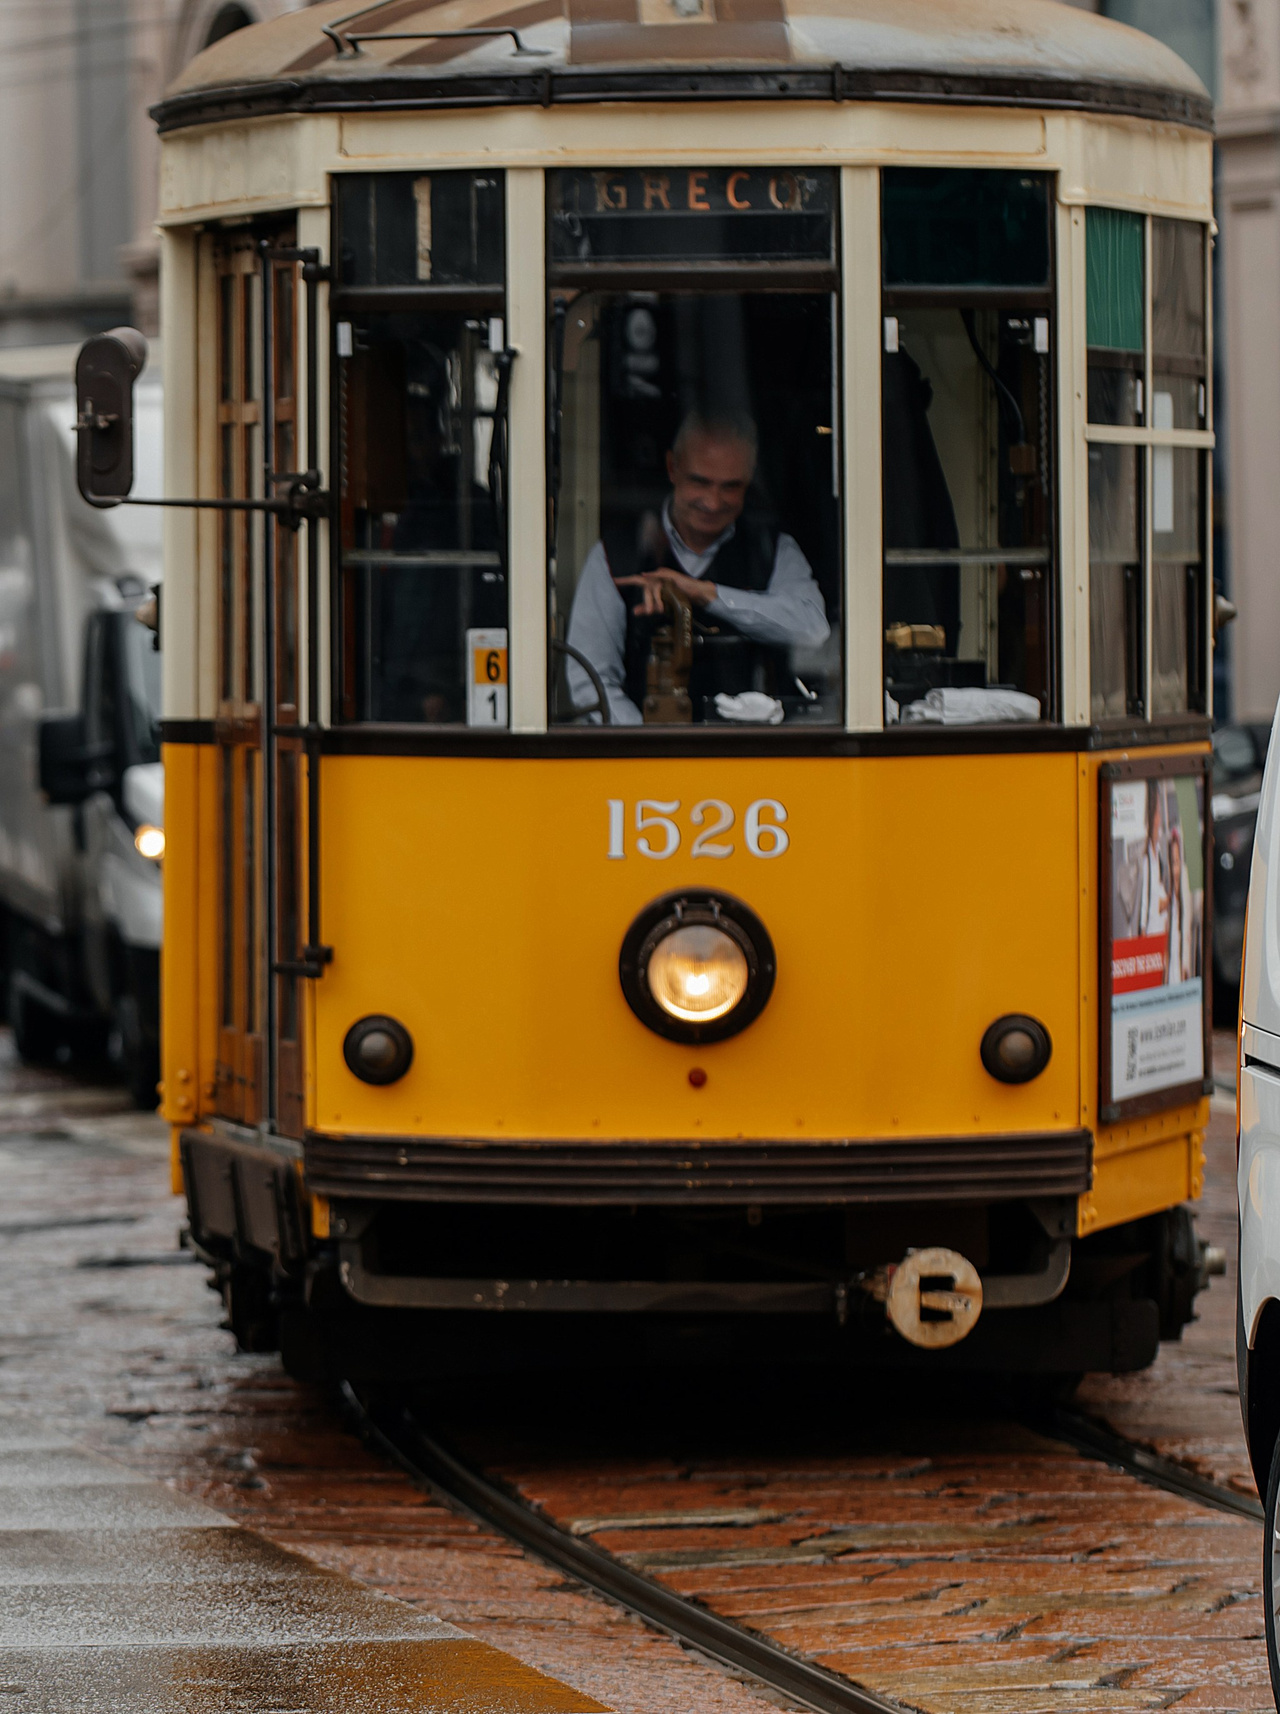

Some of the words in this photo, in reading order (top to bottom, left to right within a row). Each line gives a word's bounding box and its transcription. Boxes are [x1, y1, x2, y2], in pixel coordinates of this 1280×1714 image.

[598, 171, 800, 211] GRECO
[486, 651, 501, 682] 6
[487, 690, 497, 722] 1
[606, 798, 790, 860] 1526
